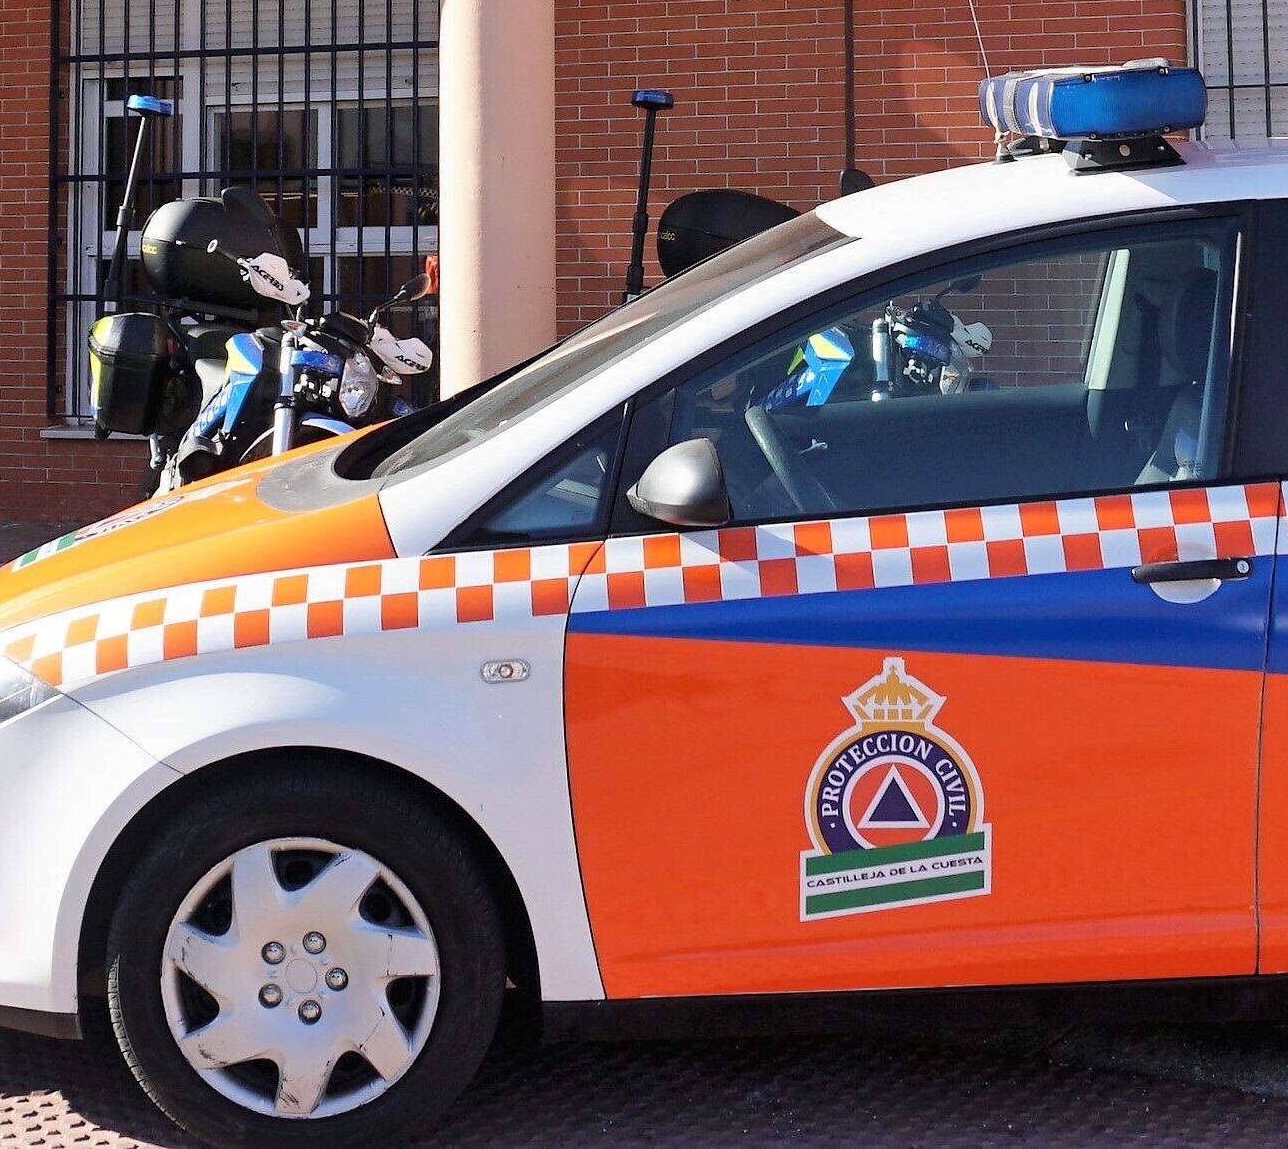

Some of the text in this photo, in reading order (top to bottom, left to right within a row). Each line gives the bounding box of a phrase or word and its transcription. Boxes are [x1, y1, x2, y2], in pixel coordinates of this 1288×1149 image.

[821, 733, 967, 818] PROTECCION CIVIL
[806, 855, 984, 888] CASTILLEJA DE LA CUESTA
